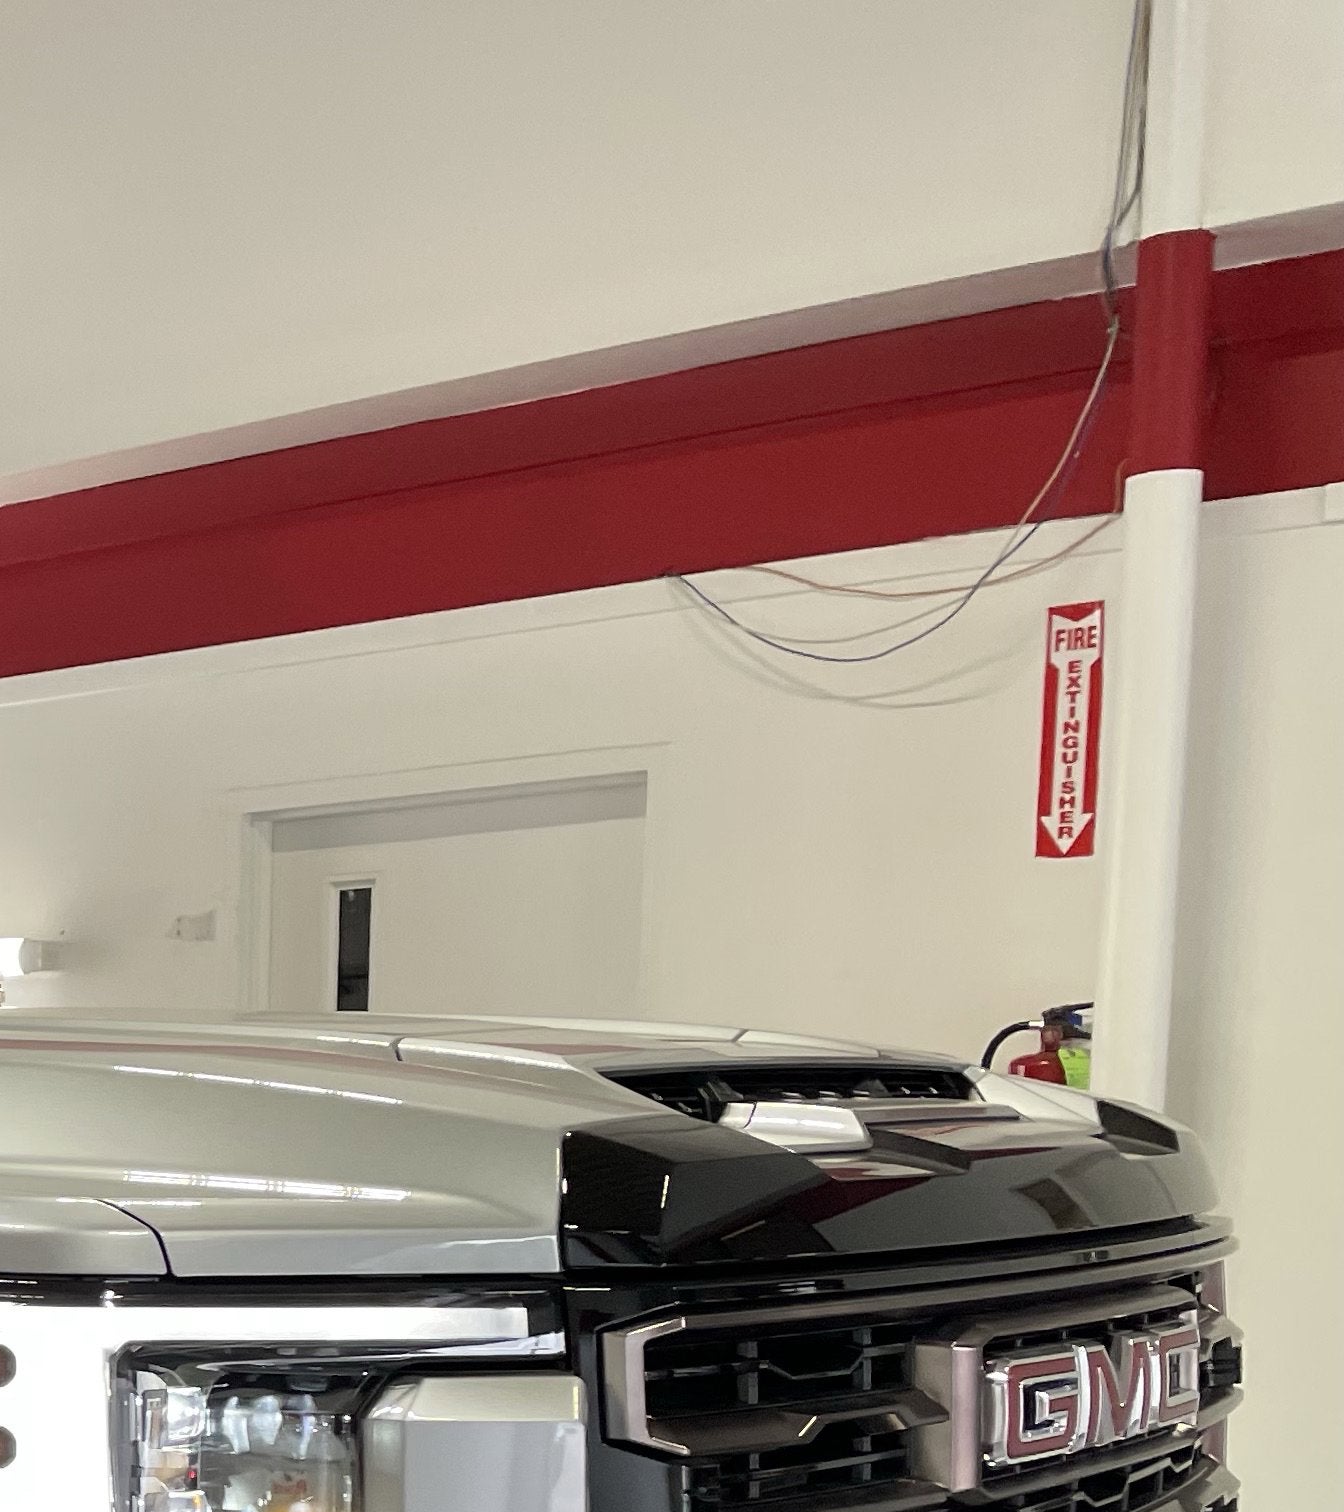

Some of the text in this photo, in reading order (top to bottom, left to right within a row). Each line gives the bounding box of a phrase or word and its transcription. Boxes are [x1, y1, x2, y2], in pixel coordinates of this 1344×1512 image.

[1054, 625, 1097, 652] FIRE
[1057, 659, 1083, 840] EXTINGUISHER
[982, 1310, 1200, 1466] GMC
